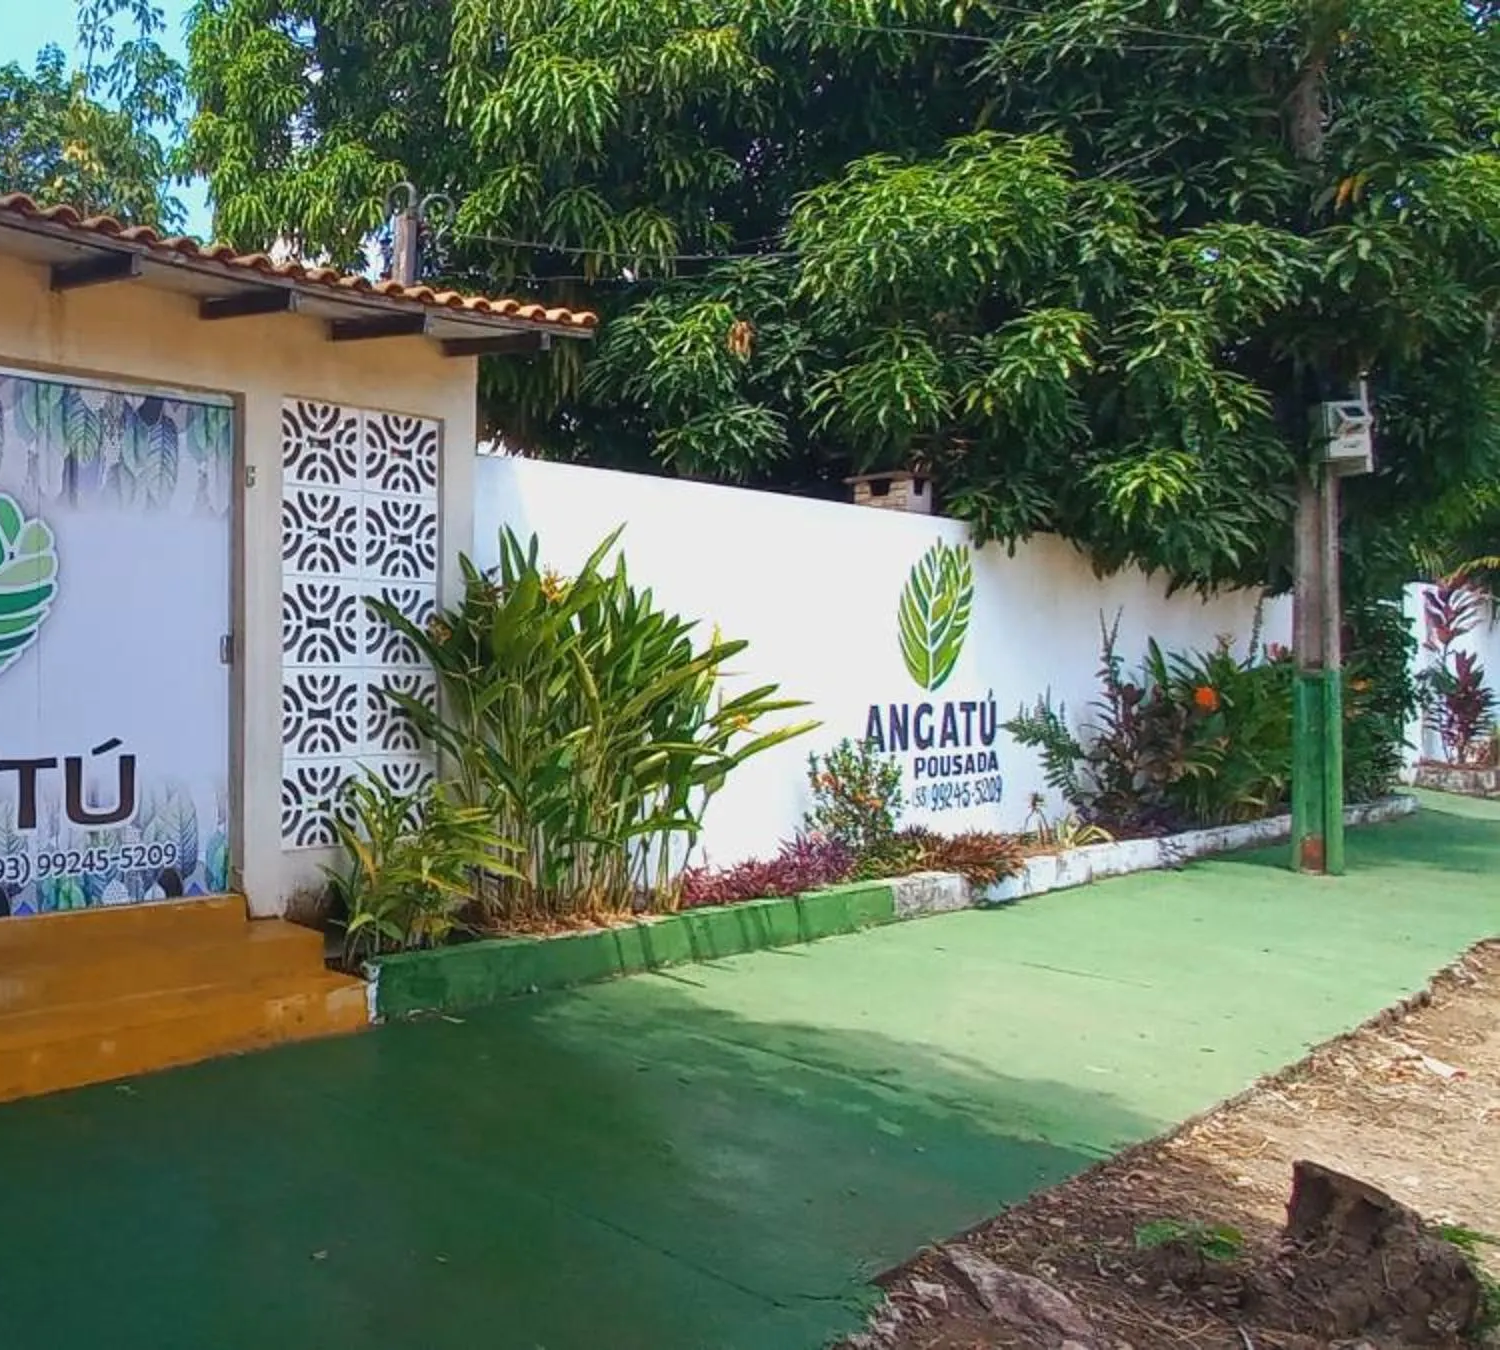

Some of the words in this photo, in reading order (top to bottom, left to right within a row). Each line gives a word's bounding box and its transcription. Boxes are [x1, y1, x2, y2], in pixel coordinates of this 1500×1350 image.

[865, 688, 997, 752] ANGATÚ
[914, 751, 999, 779] POUSADA
[37, 843, 176, 878] 99245-5209
